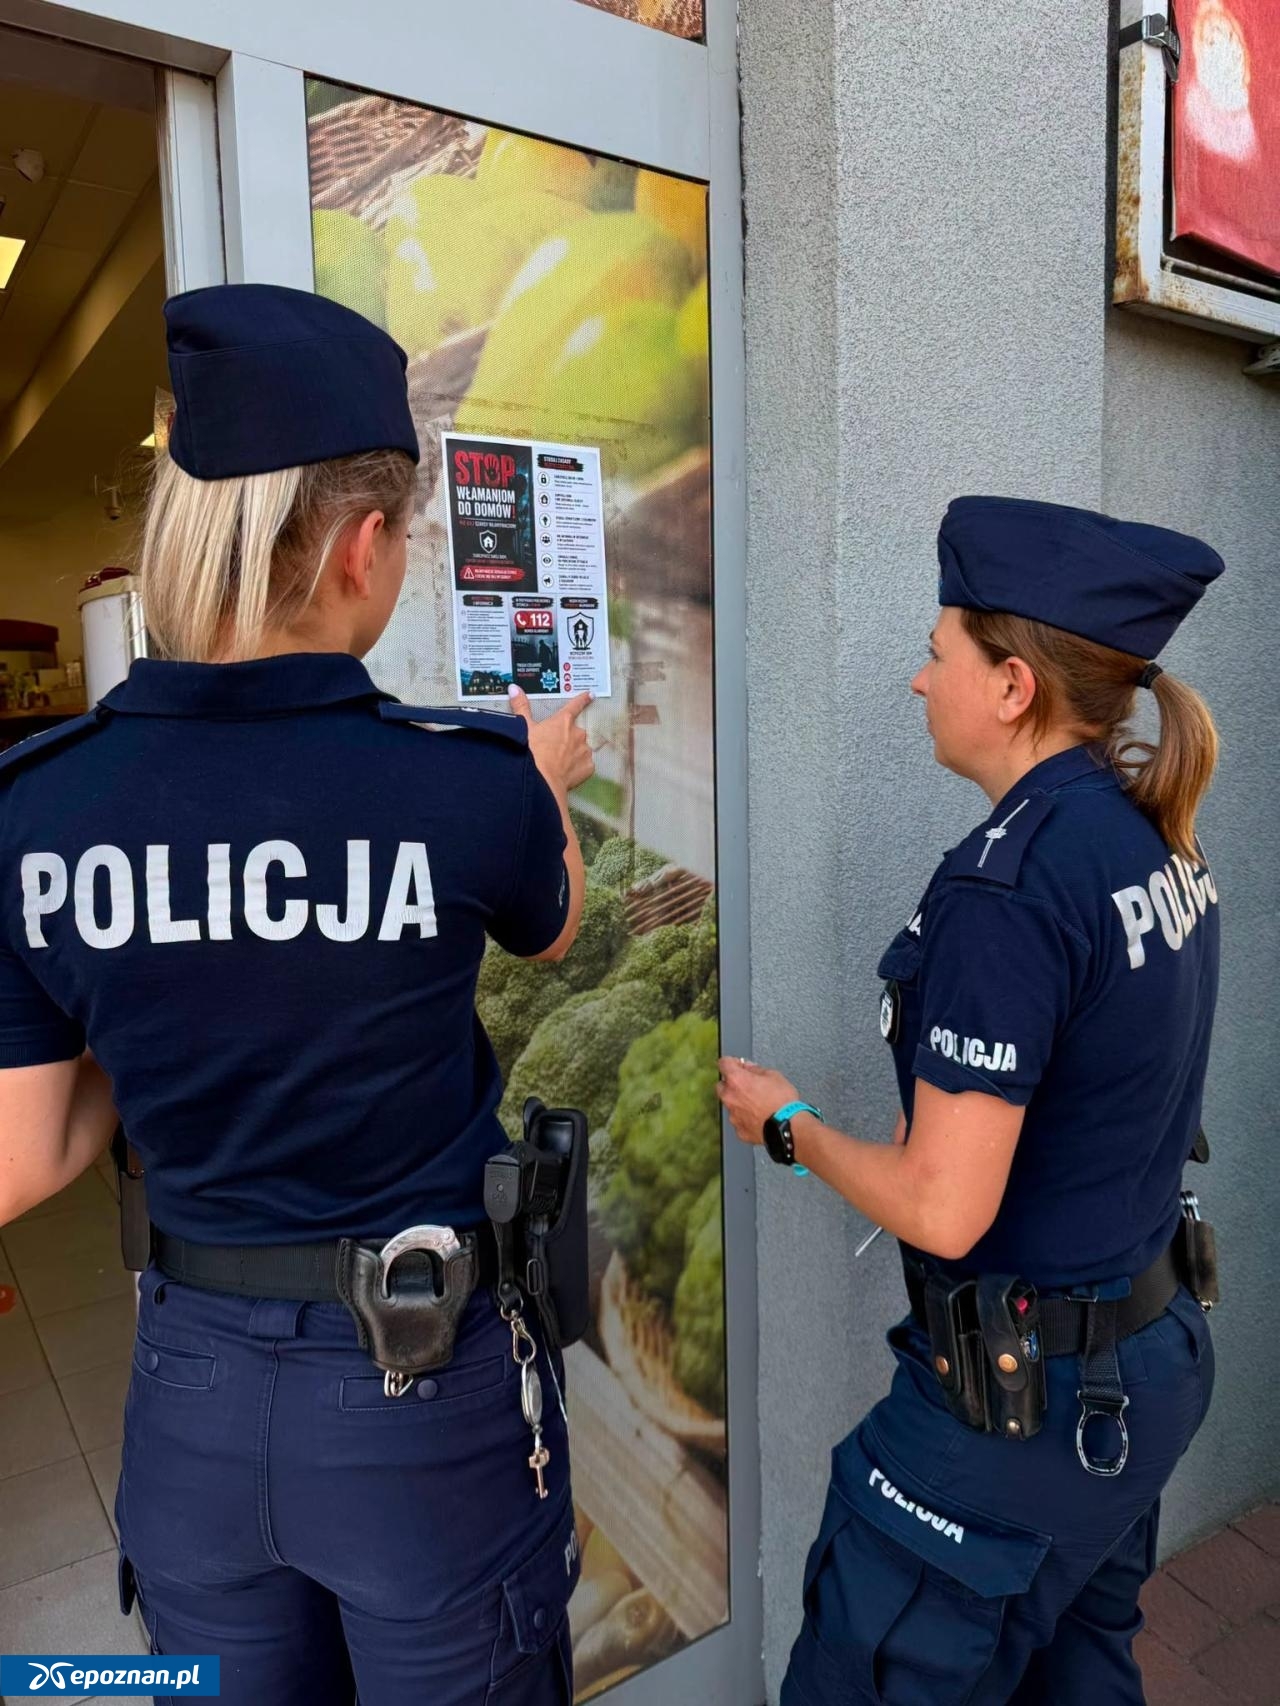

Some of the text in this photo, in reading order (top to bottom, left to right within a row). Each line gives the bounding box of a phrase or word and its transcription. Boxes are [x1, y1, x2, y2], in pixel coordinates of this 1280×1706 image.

[454, 450, 516, 488] STOP
[458, 501, 471, 516] DO
[530, 612, 550, 627] 112
[20, 839, 438, 949] POLICJA
[930, 1025, 1017, 1072] POLICJA
